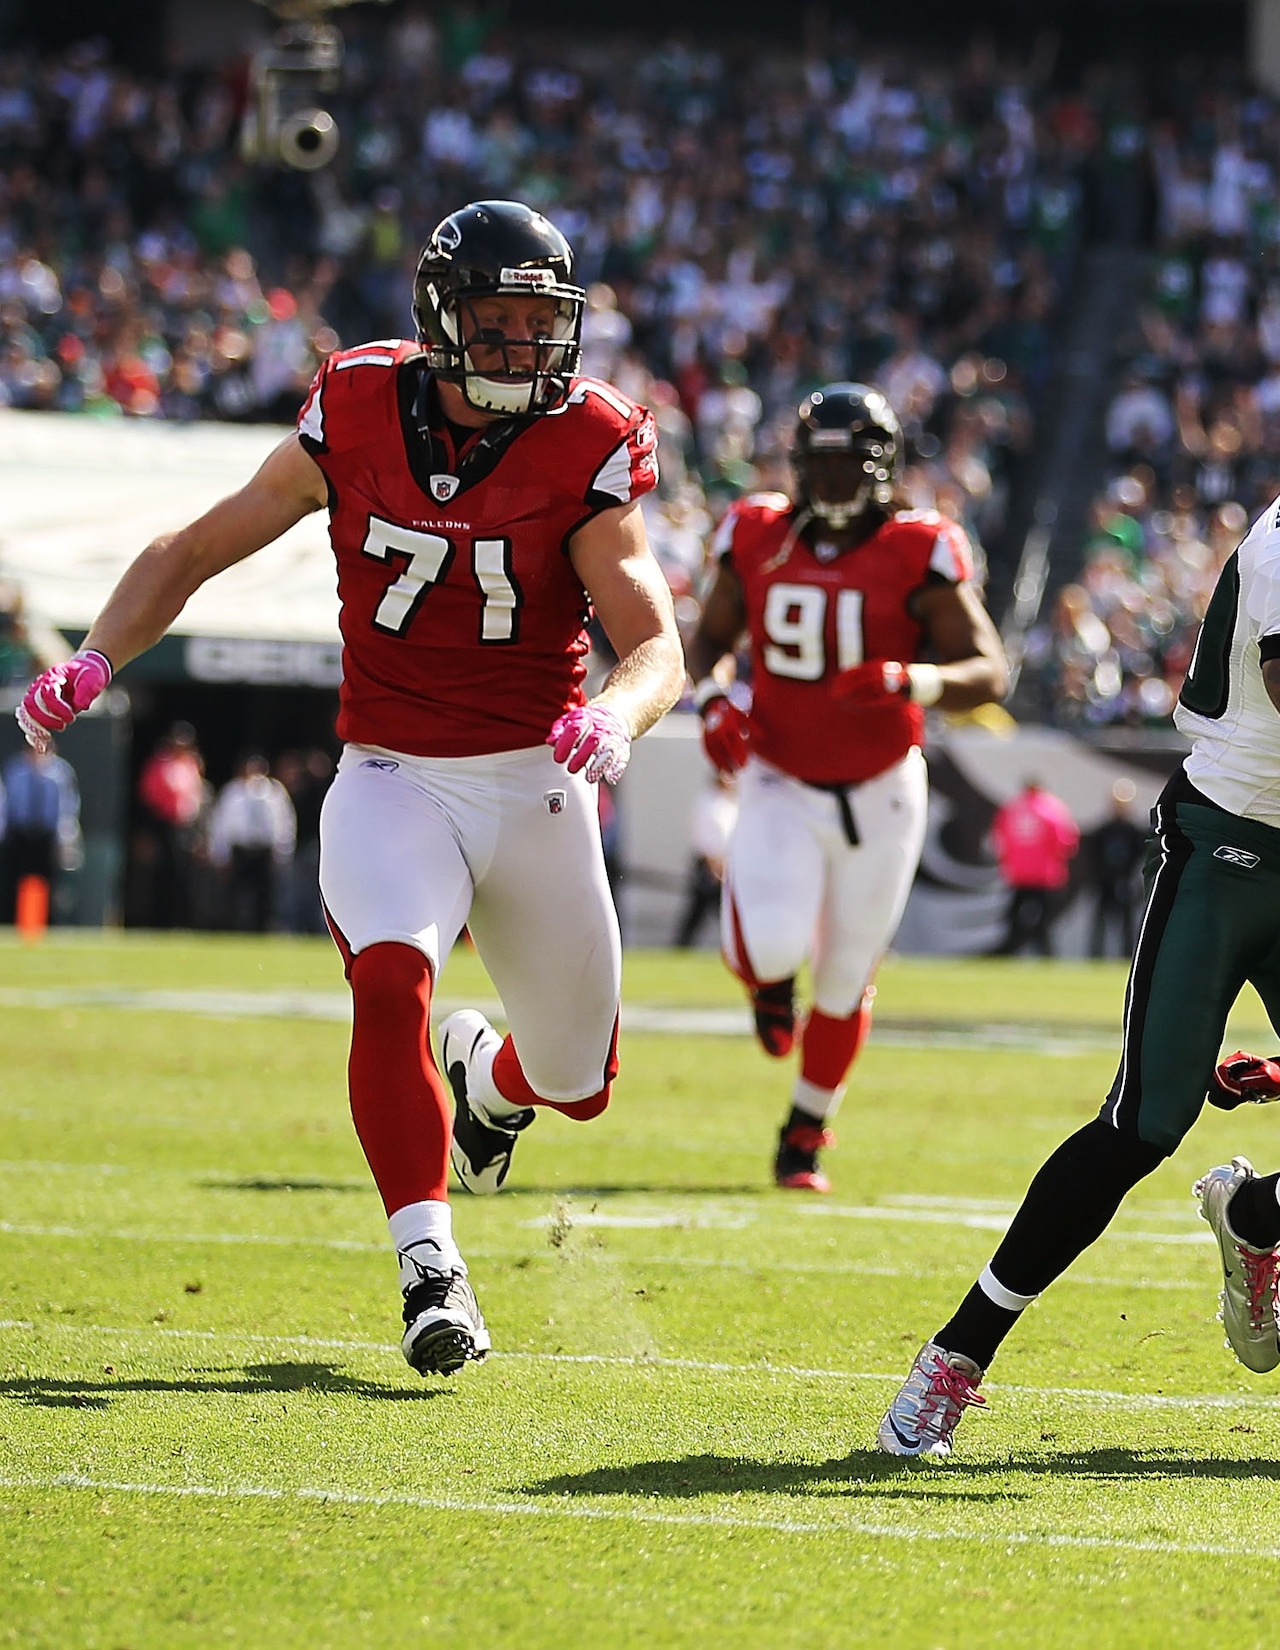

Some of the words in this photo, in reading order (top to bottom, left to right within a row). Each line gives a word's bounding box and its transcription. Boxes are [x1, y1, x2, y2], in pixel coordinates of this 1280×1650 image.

[513, 272, 543, 281] Riddell
[412, 519, 471, 531] FALCONS
[361, 513, 519, 642] 71
[762, 582, 865, 682] 91
